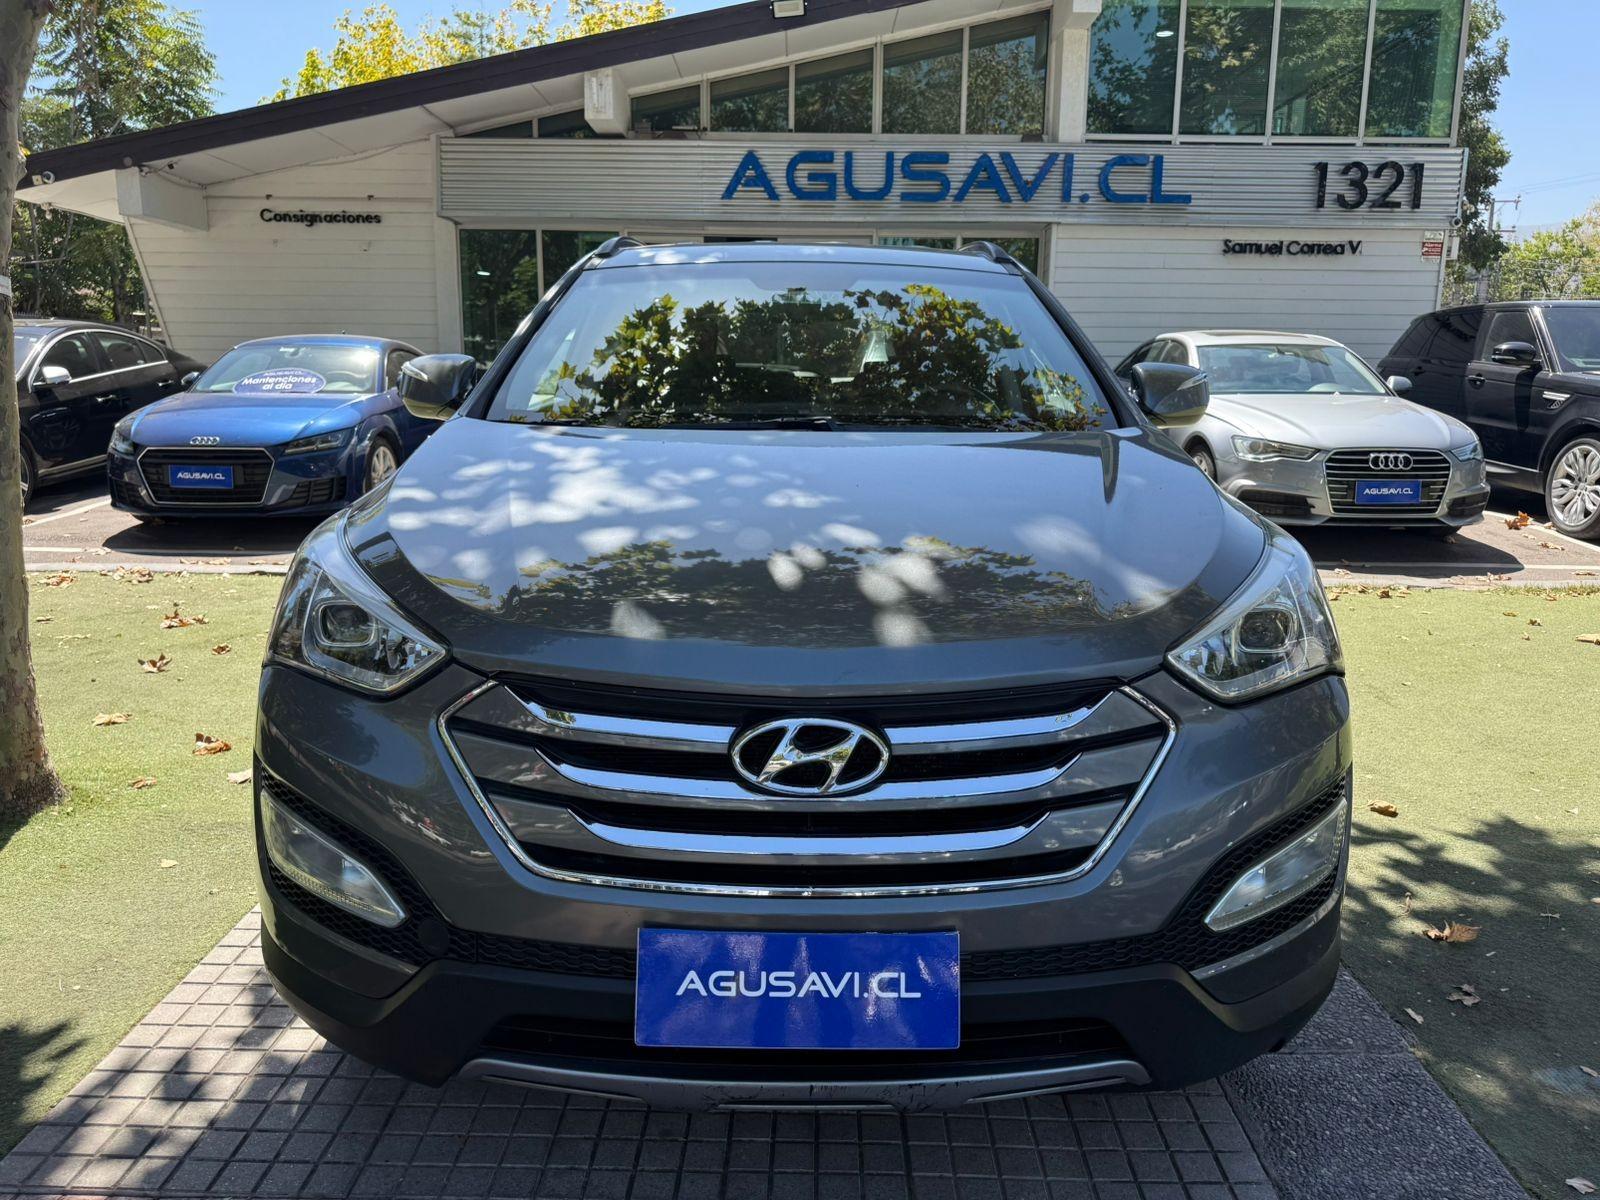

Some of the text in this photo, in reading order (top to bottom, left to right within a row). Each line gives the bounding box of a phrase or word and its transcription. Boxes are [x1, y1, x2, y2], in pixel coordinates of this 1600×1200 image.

[720, 149, 1192, 204] AGUSAVI.CL
[1314, 160, 1425, 210] 1321
[260, 208, 382, 227] Consignaciones
[1223, 239, 1283, 255] Samuel
[1286, 241, 1345, 256] Correa
[241, 374, 318, 386] Mantenciones
[262, 382, 274, 391] al
[176, 471, 226, 481] AGUSAVI.CL
[1363, 487, 1414, 495] AGUSAVI.CL
[675, 969, 922, 999] AGUSAVI.CL
